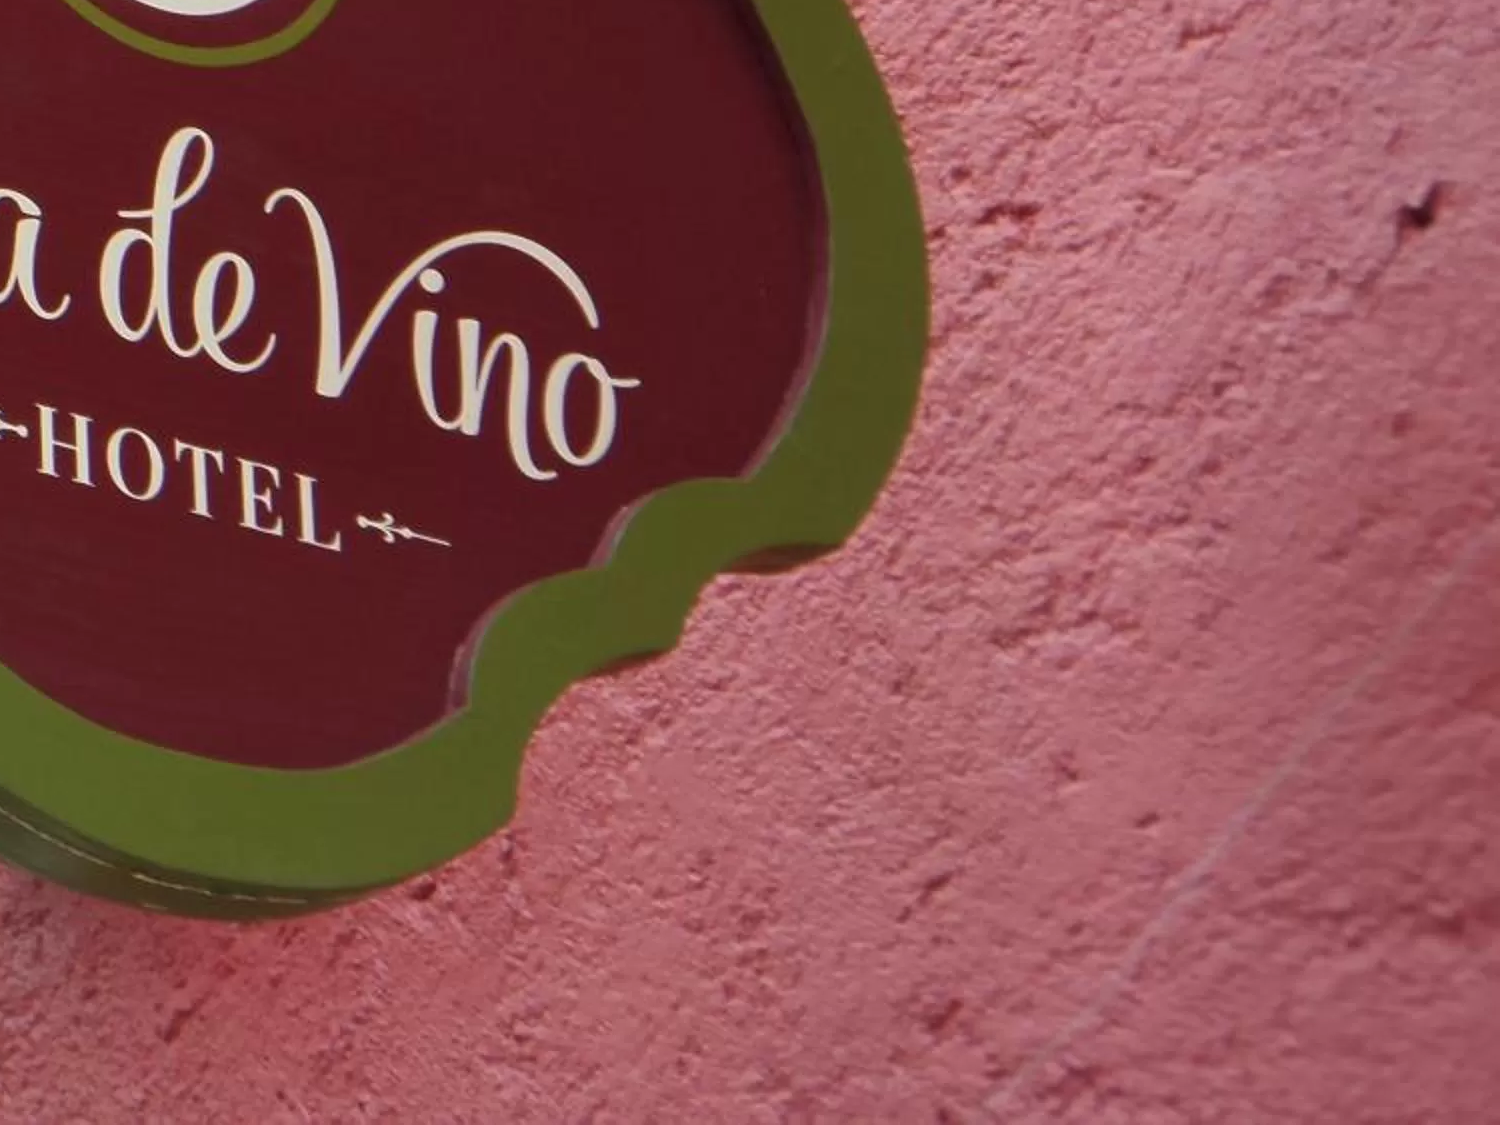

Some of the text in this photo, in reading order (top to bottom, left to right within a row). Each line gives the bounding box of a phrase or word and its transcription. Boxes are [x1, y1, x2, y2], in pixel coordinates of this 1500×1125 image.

[99, 126, 276, 373] de
[264, 188, 641, 481] Vino
[34, 403, 342, 553] HOTEL
